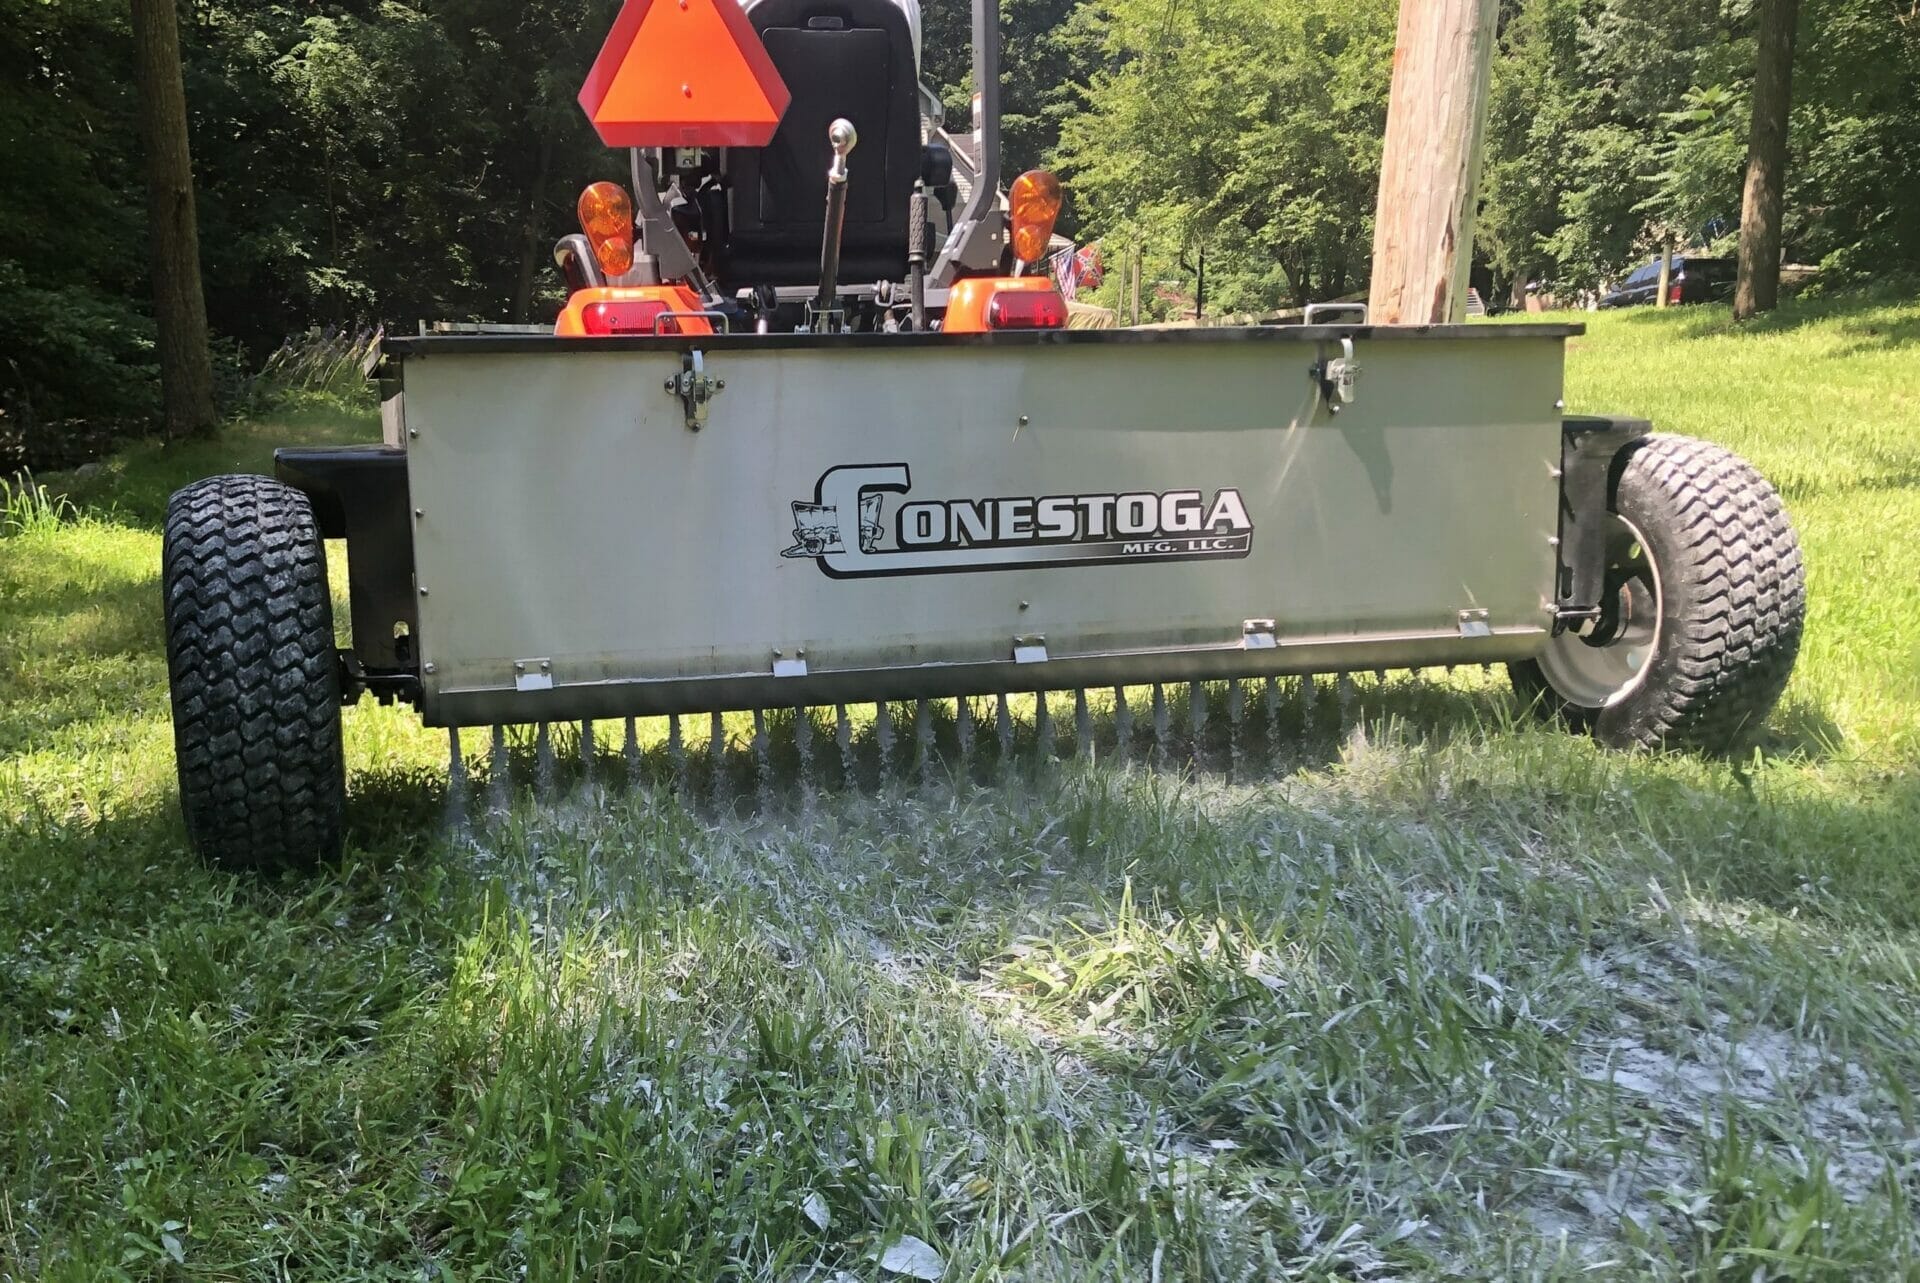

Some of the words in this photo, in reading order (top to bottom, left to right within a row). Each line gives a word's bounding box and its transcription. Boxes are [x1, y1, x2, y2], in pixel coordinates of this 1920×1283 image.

[815, 463, 1254, 576] CONESTOGA
[1121, 541, 1178, 554] MFG.
[1187, 539, 1234, 551] LLC.
